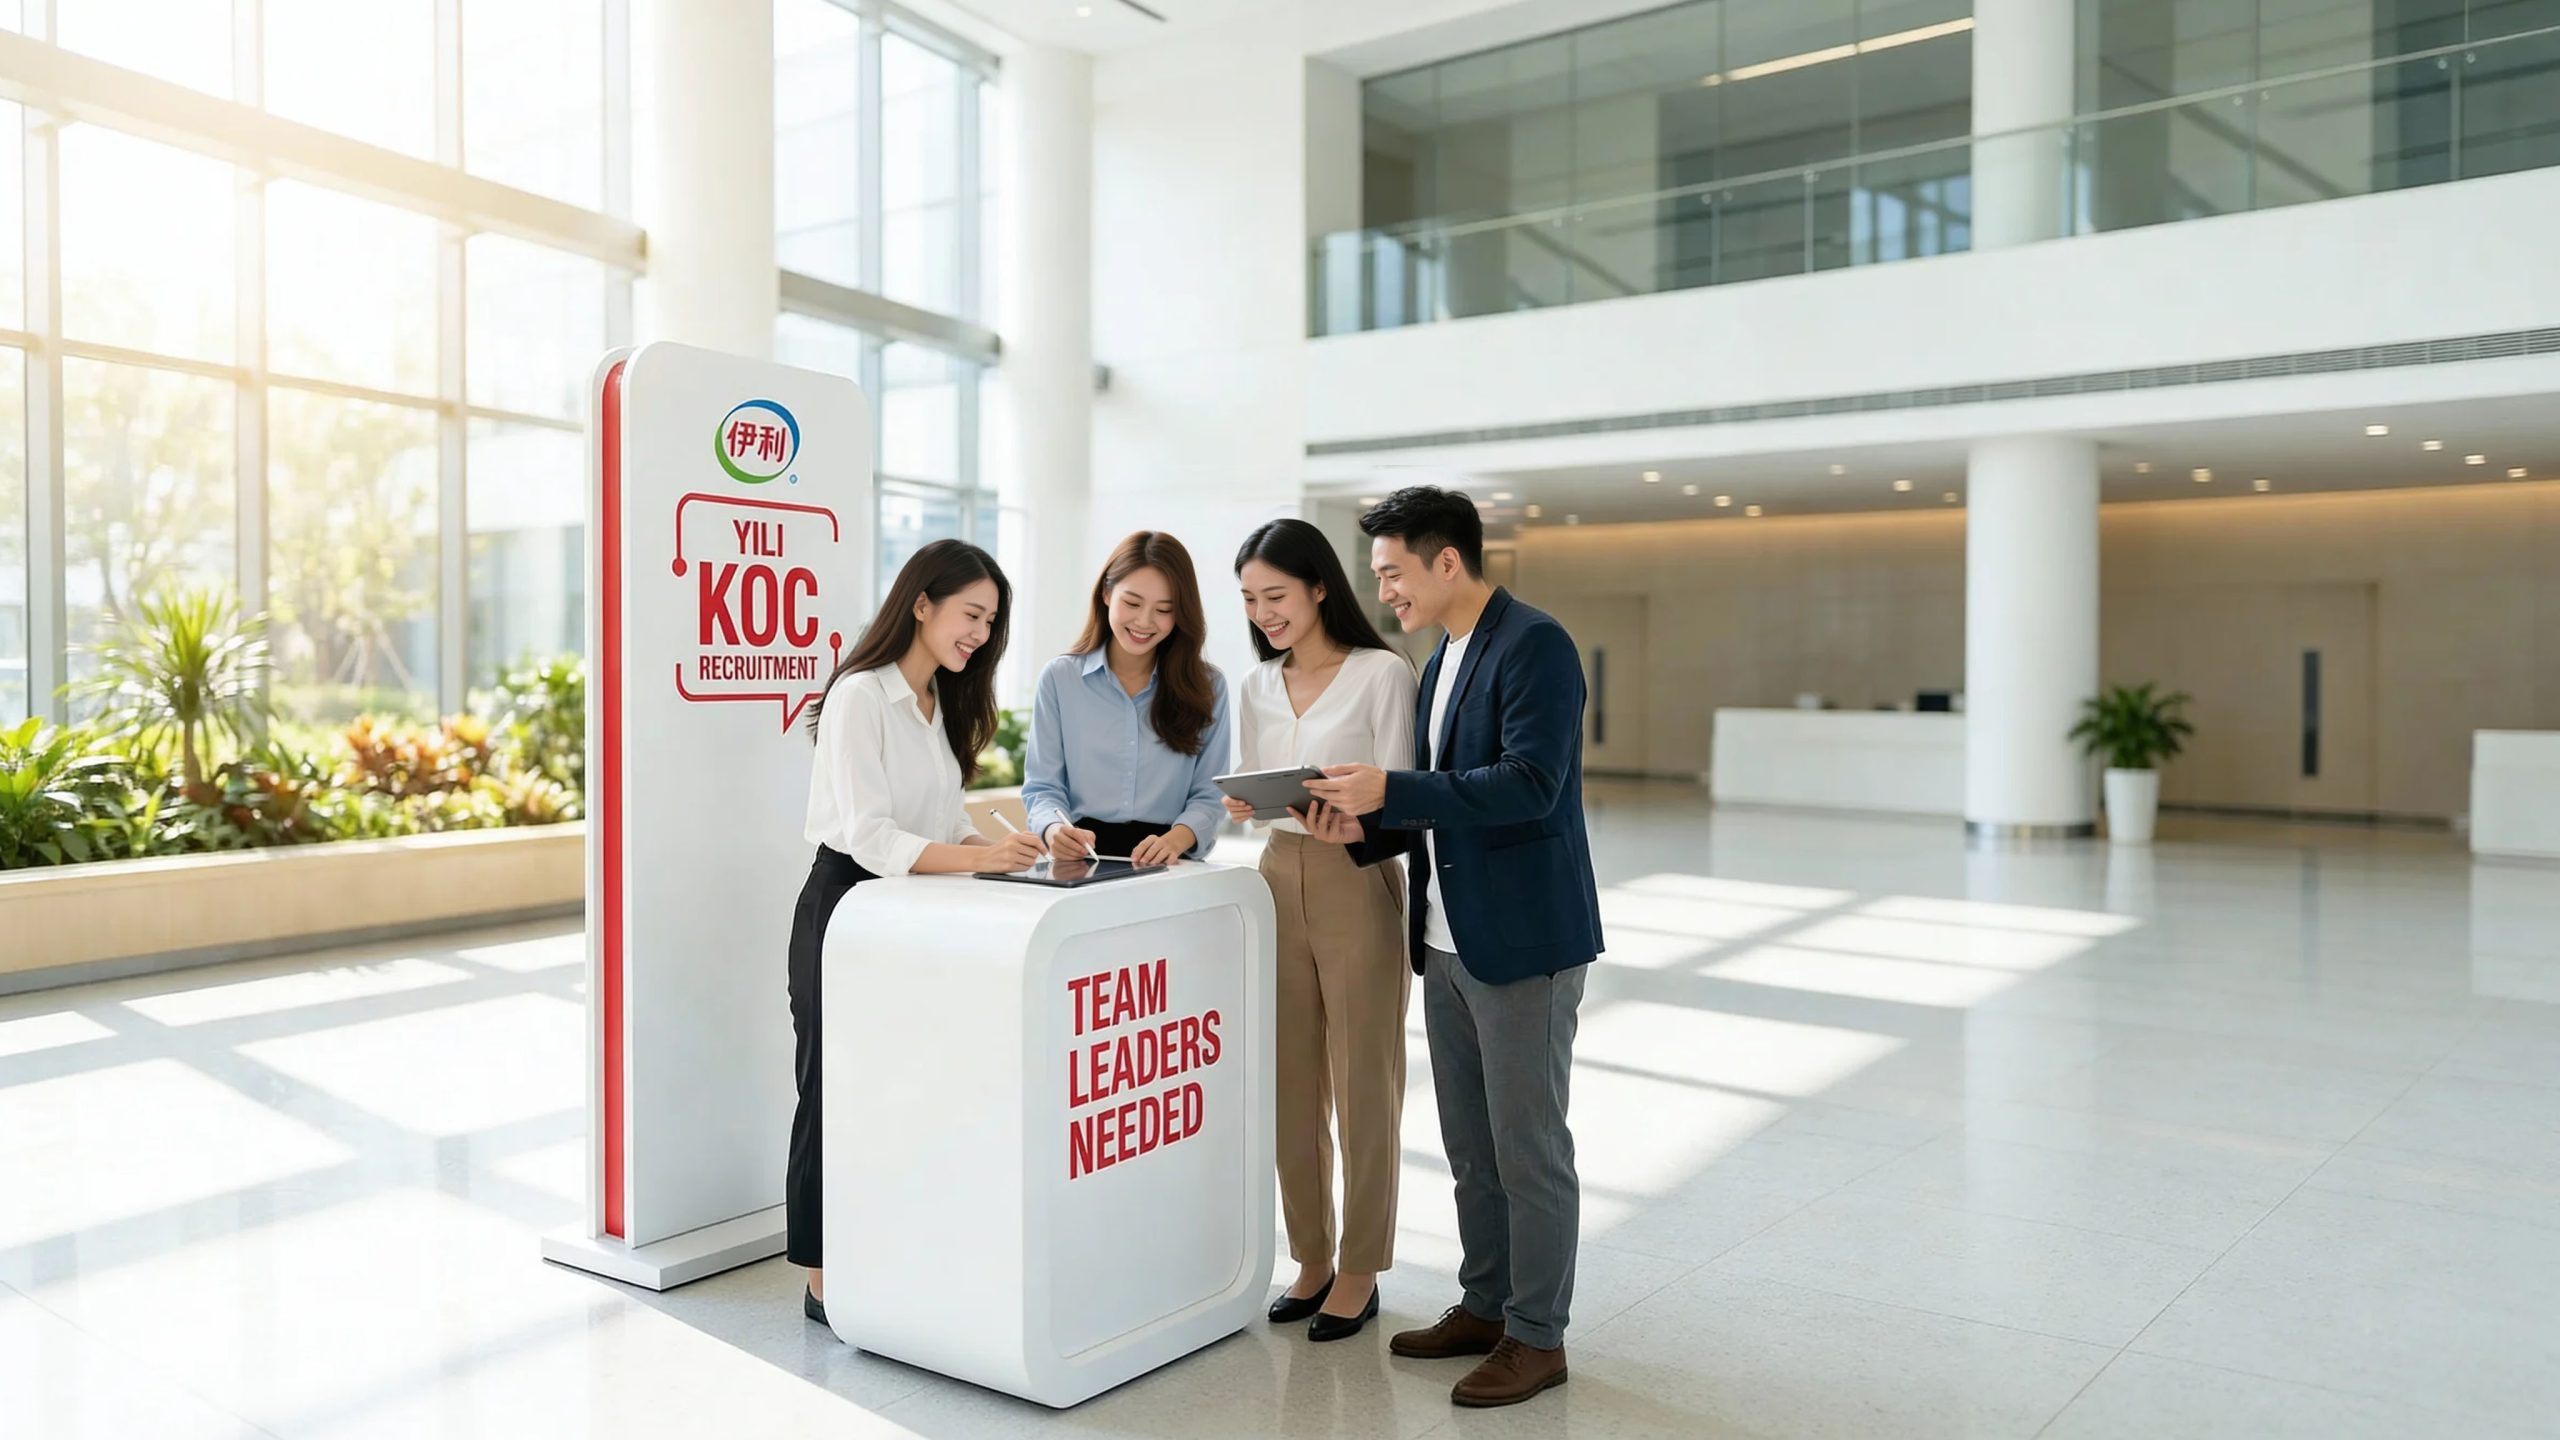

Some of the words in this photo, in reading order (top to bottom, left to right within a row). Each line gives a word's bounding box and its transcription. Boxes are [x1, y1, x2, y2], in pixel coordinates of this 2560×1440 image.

[727, 420, 786, 462] 伊利
[733, 520, 784, 557] YILI
[699, 561, 819, 649] KOC
[699, 655, 818, 681] RECRUITMENT
[1067, 958, 1167, 1036] TEAM
[1069, 1010, 1221, 1109] LEADERS
[1069, 1081, 1204, 1180] NEEDED
